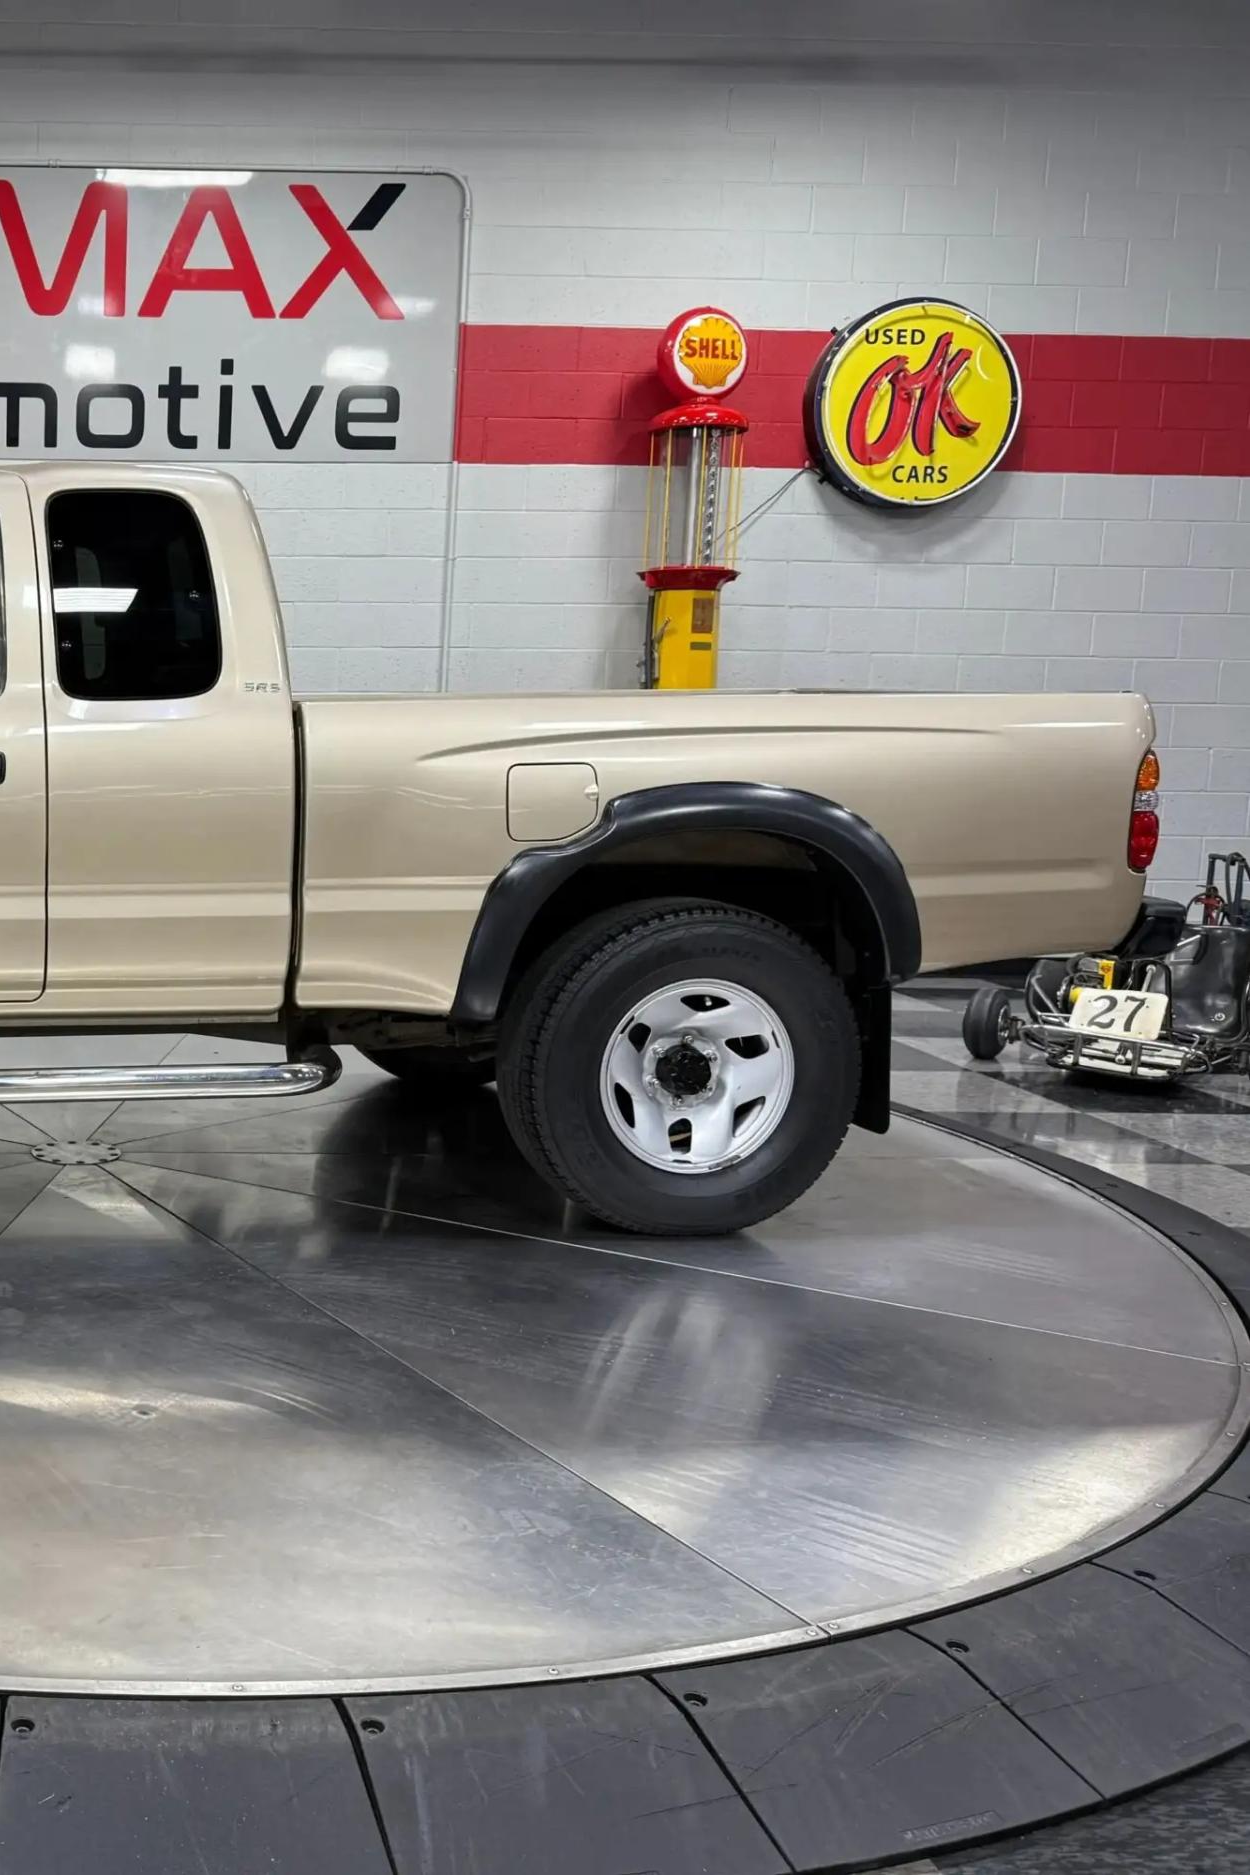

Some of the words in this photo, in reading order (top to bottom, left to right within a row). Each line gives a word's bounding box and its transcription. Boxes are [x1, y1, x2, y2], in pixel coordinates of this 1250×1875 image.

[864, 328, 926, 345] USED
[684, 337, 739, 361] SHELL
[846, 331, 982, 467] OK
[892, 465, 949, 483] CARS
[1086, 994, 1148, 1032] 27
